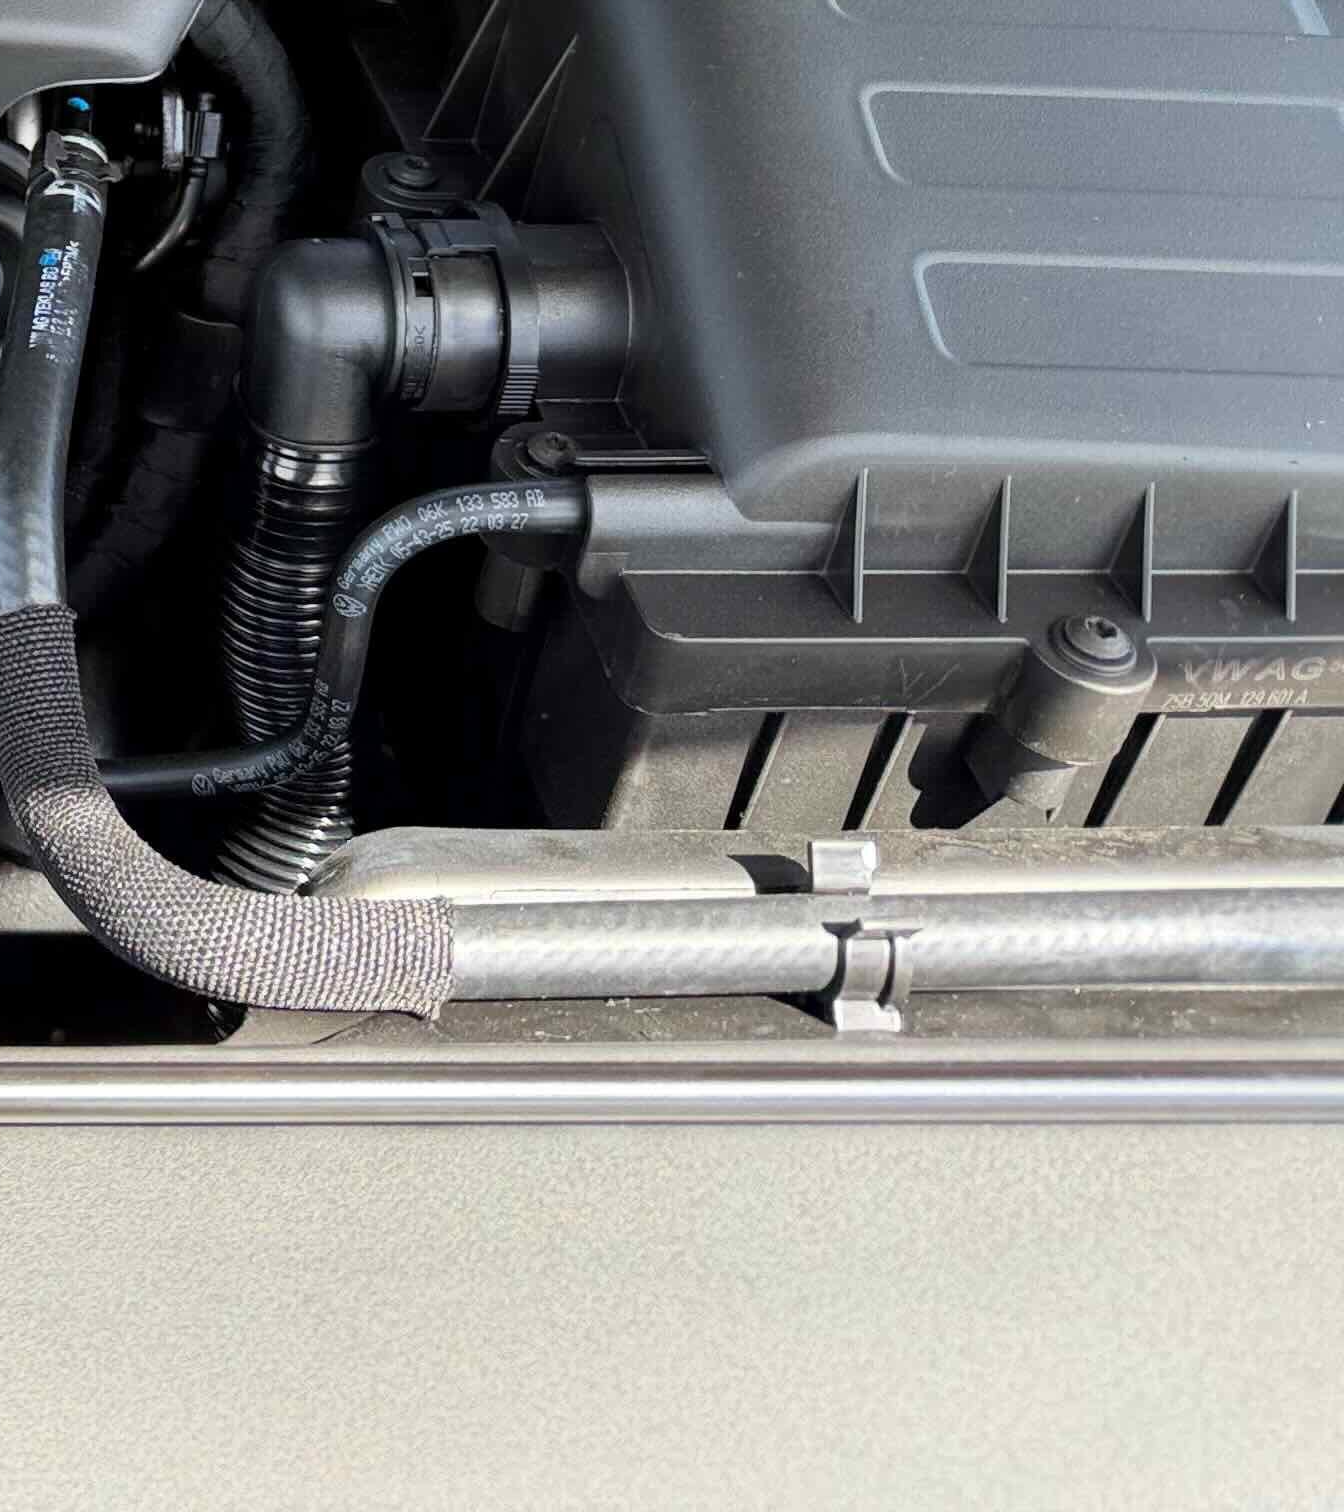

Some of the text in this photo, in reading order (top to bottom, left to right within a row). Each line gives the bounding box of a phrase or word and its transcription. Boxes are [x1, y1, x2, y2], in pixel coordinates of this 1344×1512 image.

[455, 493, 485, 513] 133
[510, 513, 529, 530] 27
[1177, 656, 1254, 683] VW
[1255, 656, 1326, 681] AG
